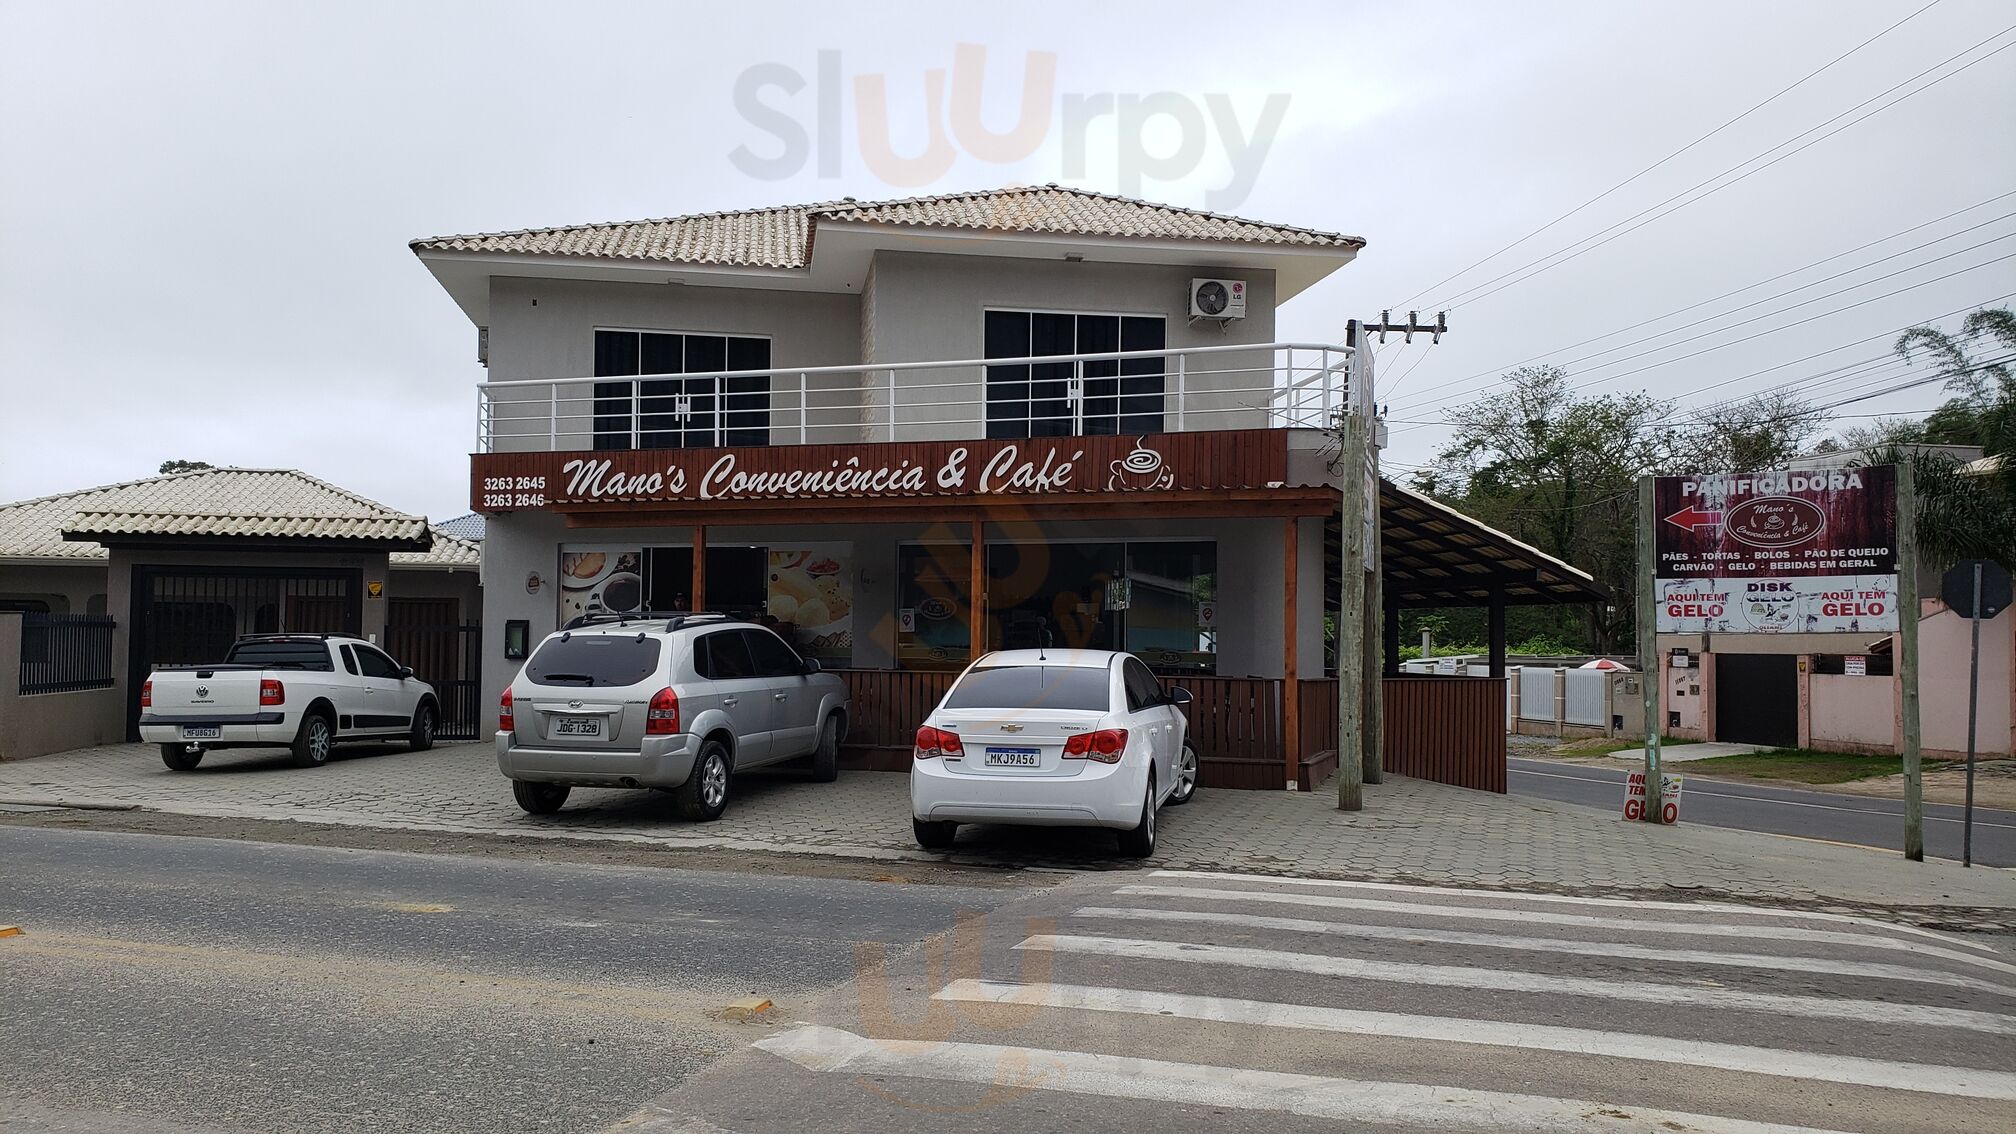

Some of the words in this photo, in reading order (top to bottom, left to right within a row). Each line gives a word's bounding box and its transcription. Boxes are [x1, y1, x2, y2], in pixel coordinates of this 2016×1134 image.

[562, 459, 687, 498] Mano's
[700, 453, 926, 499] Conveniência
[936, 447, 969, 489] &
[979, 444, 1083, 494] Café
[484, 476, 513, 491] 3263
[515, 476, 546, 490] 2645
[1682, 474, 1863, 497] PANIFICADORA
[483, 493, 513, 507] 3263
[515, 493, 545, 507] 2646
[1662, 552, 1689, 561] PÃES
[1701, 551, 1740, 560] TORTAS
[1754, 551, 1790, 560] BOLOS
[1804, 548, 1829, 558] PÃO
[1830, 548, 1845, 558] DE
[1847, 547, 1889, 557] QUEIJO
[1673, 561, 1715, 571] CARVÃO
[1728, 562, 1756, 571] GELO
[1769, 560, 1817, 570] BEBIDAS
[1819, 559, 1837, 569] EM
[1839, 558, 1877, 568] GERAL
[1747, 582, 1793, 593] DISK
[1667, 593, 1696, 602] AQUI
[1699, 593, 1725, 602] TEM
[1821, 591, 1852, 600] AQUI
[1857, 590, 1886, 599] TEM
[1667, 604, 1724, 618] GELO
[1821, 602, 1885, 617] GELO
[990, 755, 1035, 765] MKJ9A56
[1624, 799, 1678, 823] GEO
